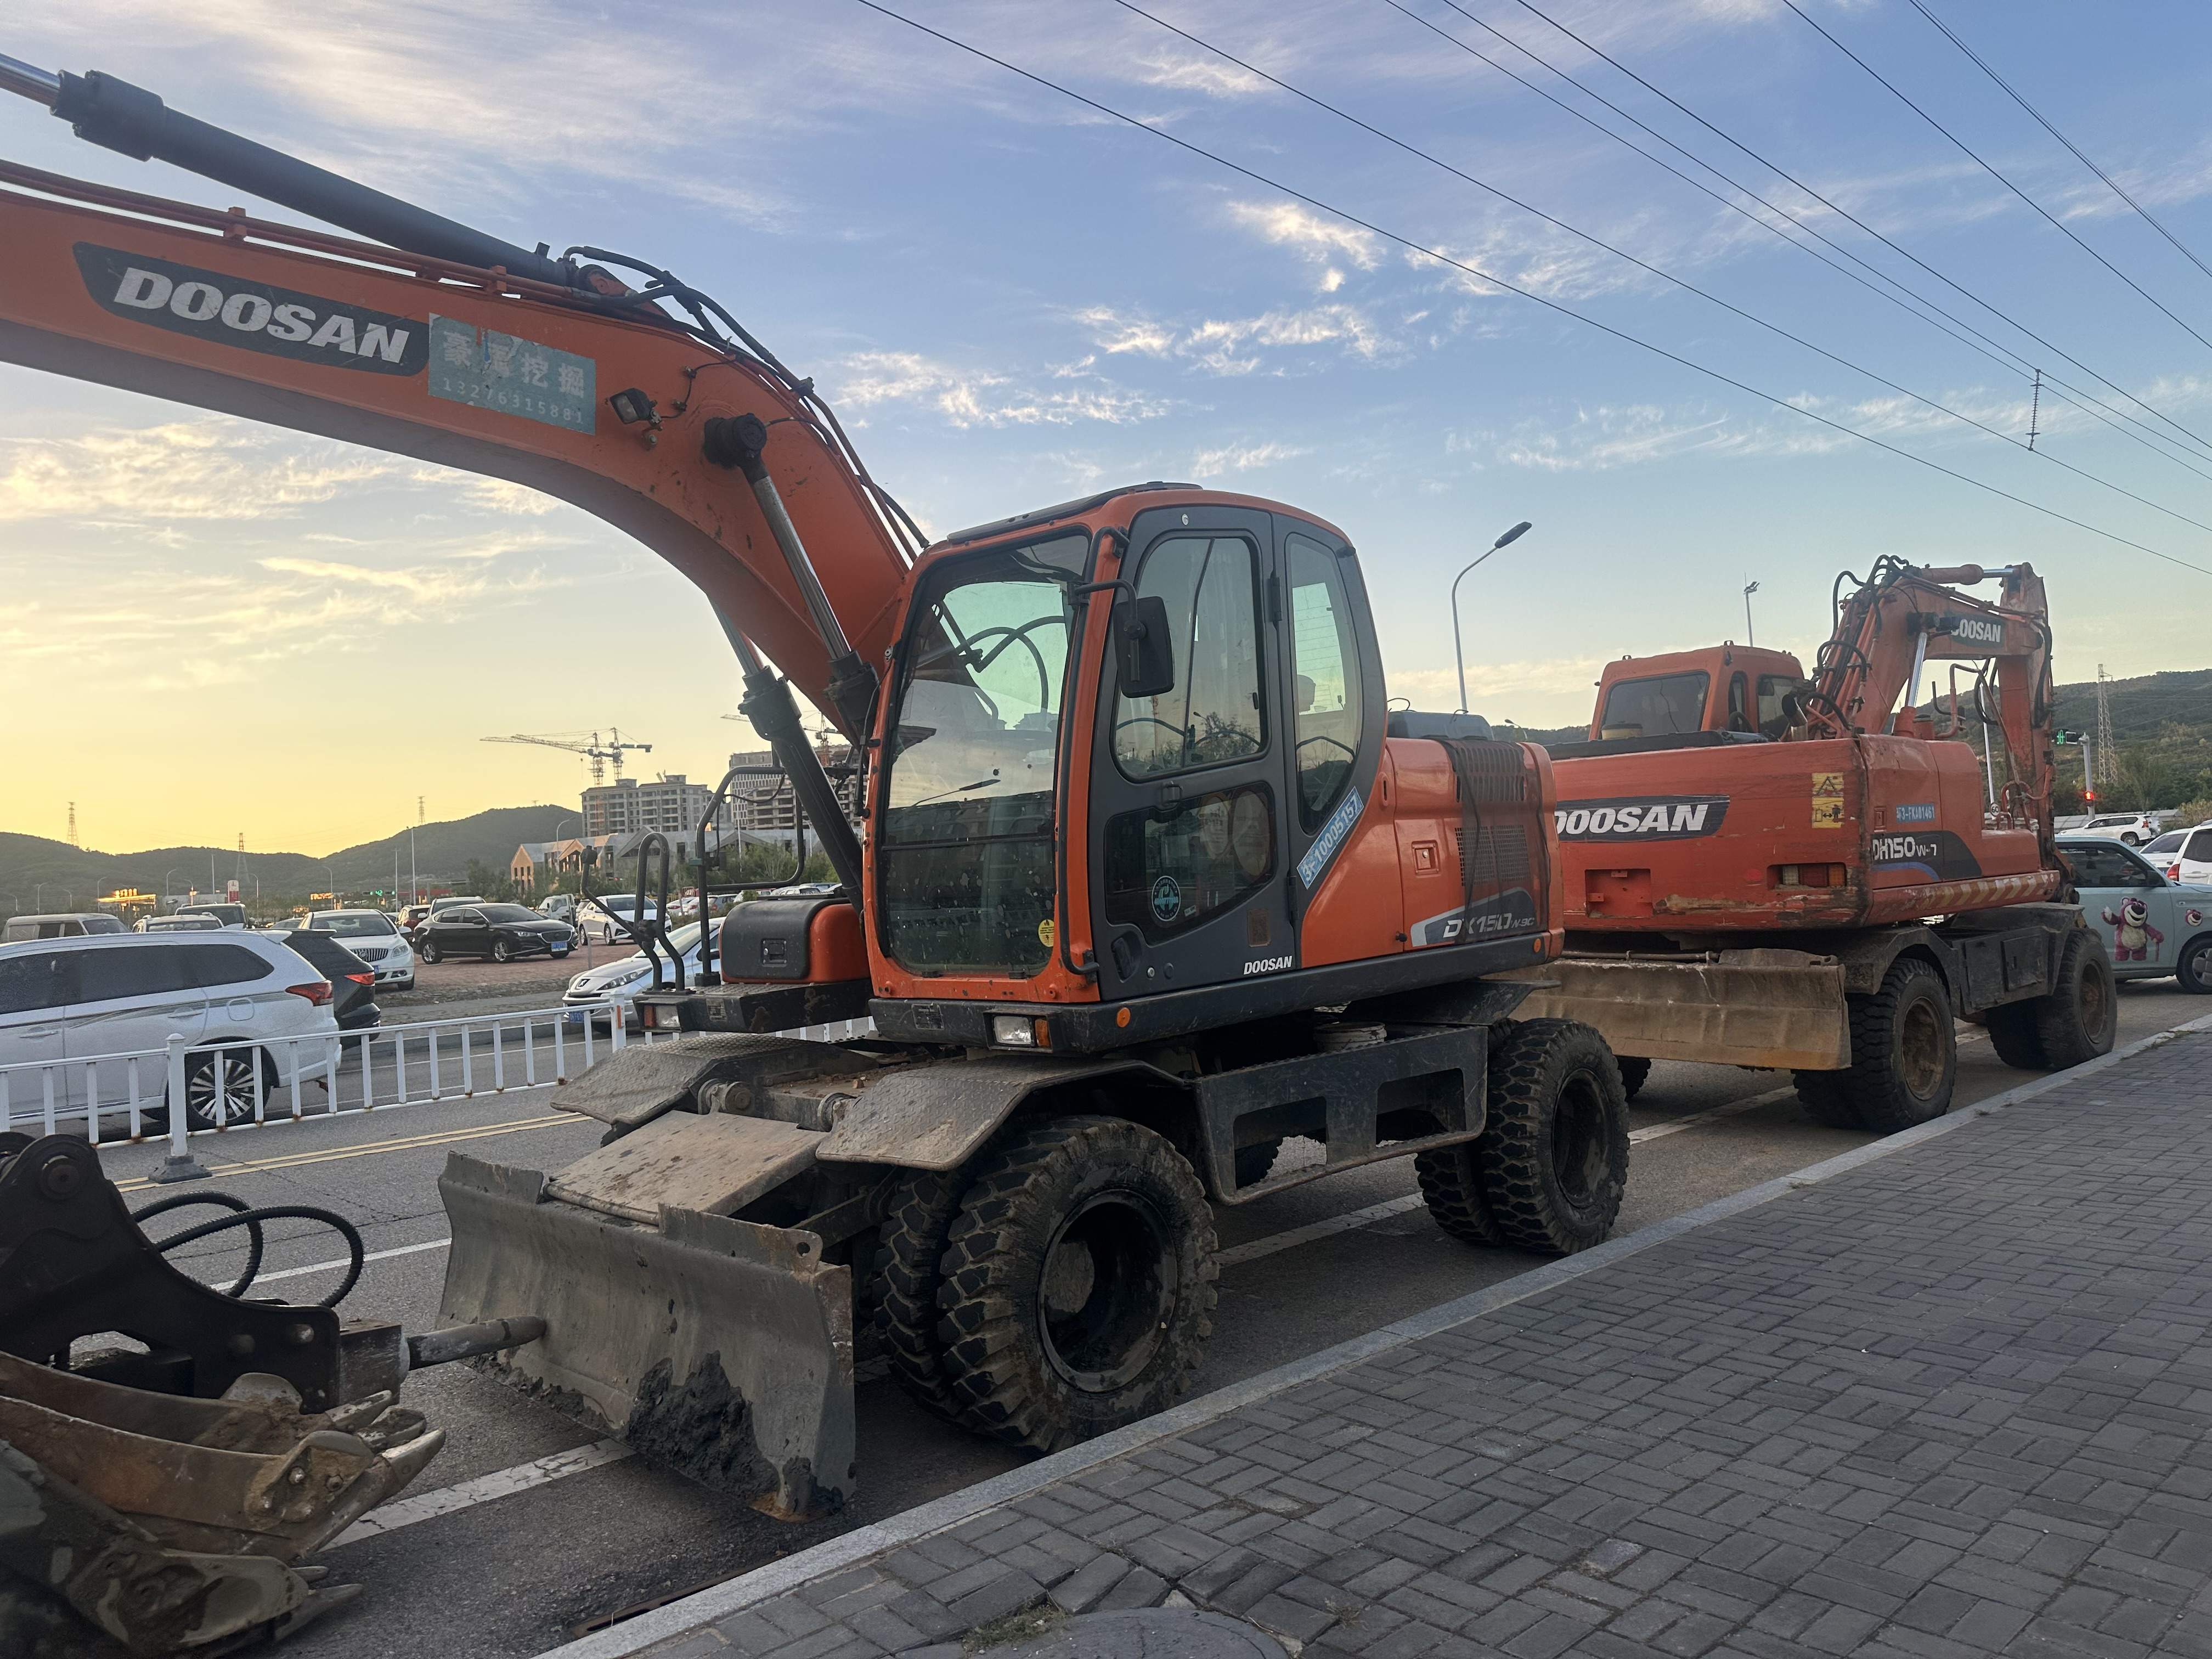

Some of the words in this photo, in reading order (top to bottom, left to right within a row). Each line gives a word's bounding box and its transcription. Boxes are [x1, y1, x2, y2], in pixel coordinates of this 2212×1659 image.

[114, 266, 410, 364] DOOSAN
[1951, 618, 2001, 642] OOSAN
[1243, 955, 1293, 975] DOOSAN
